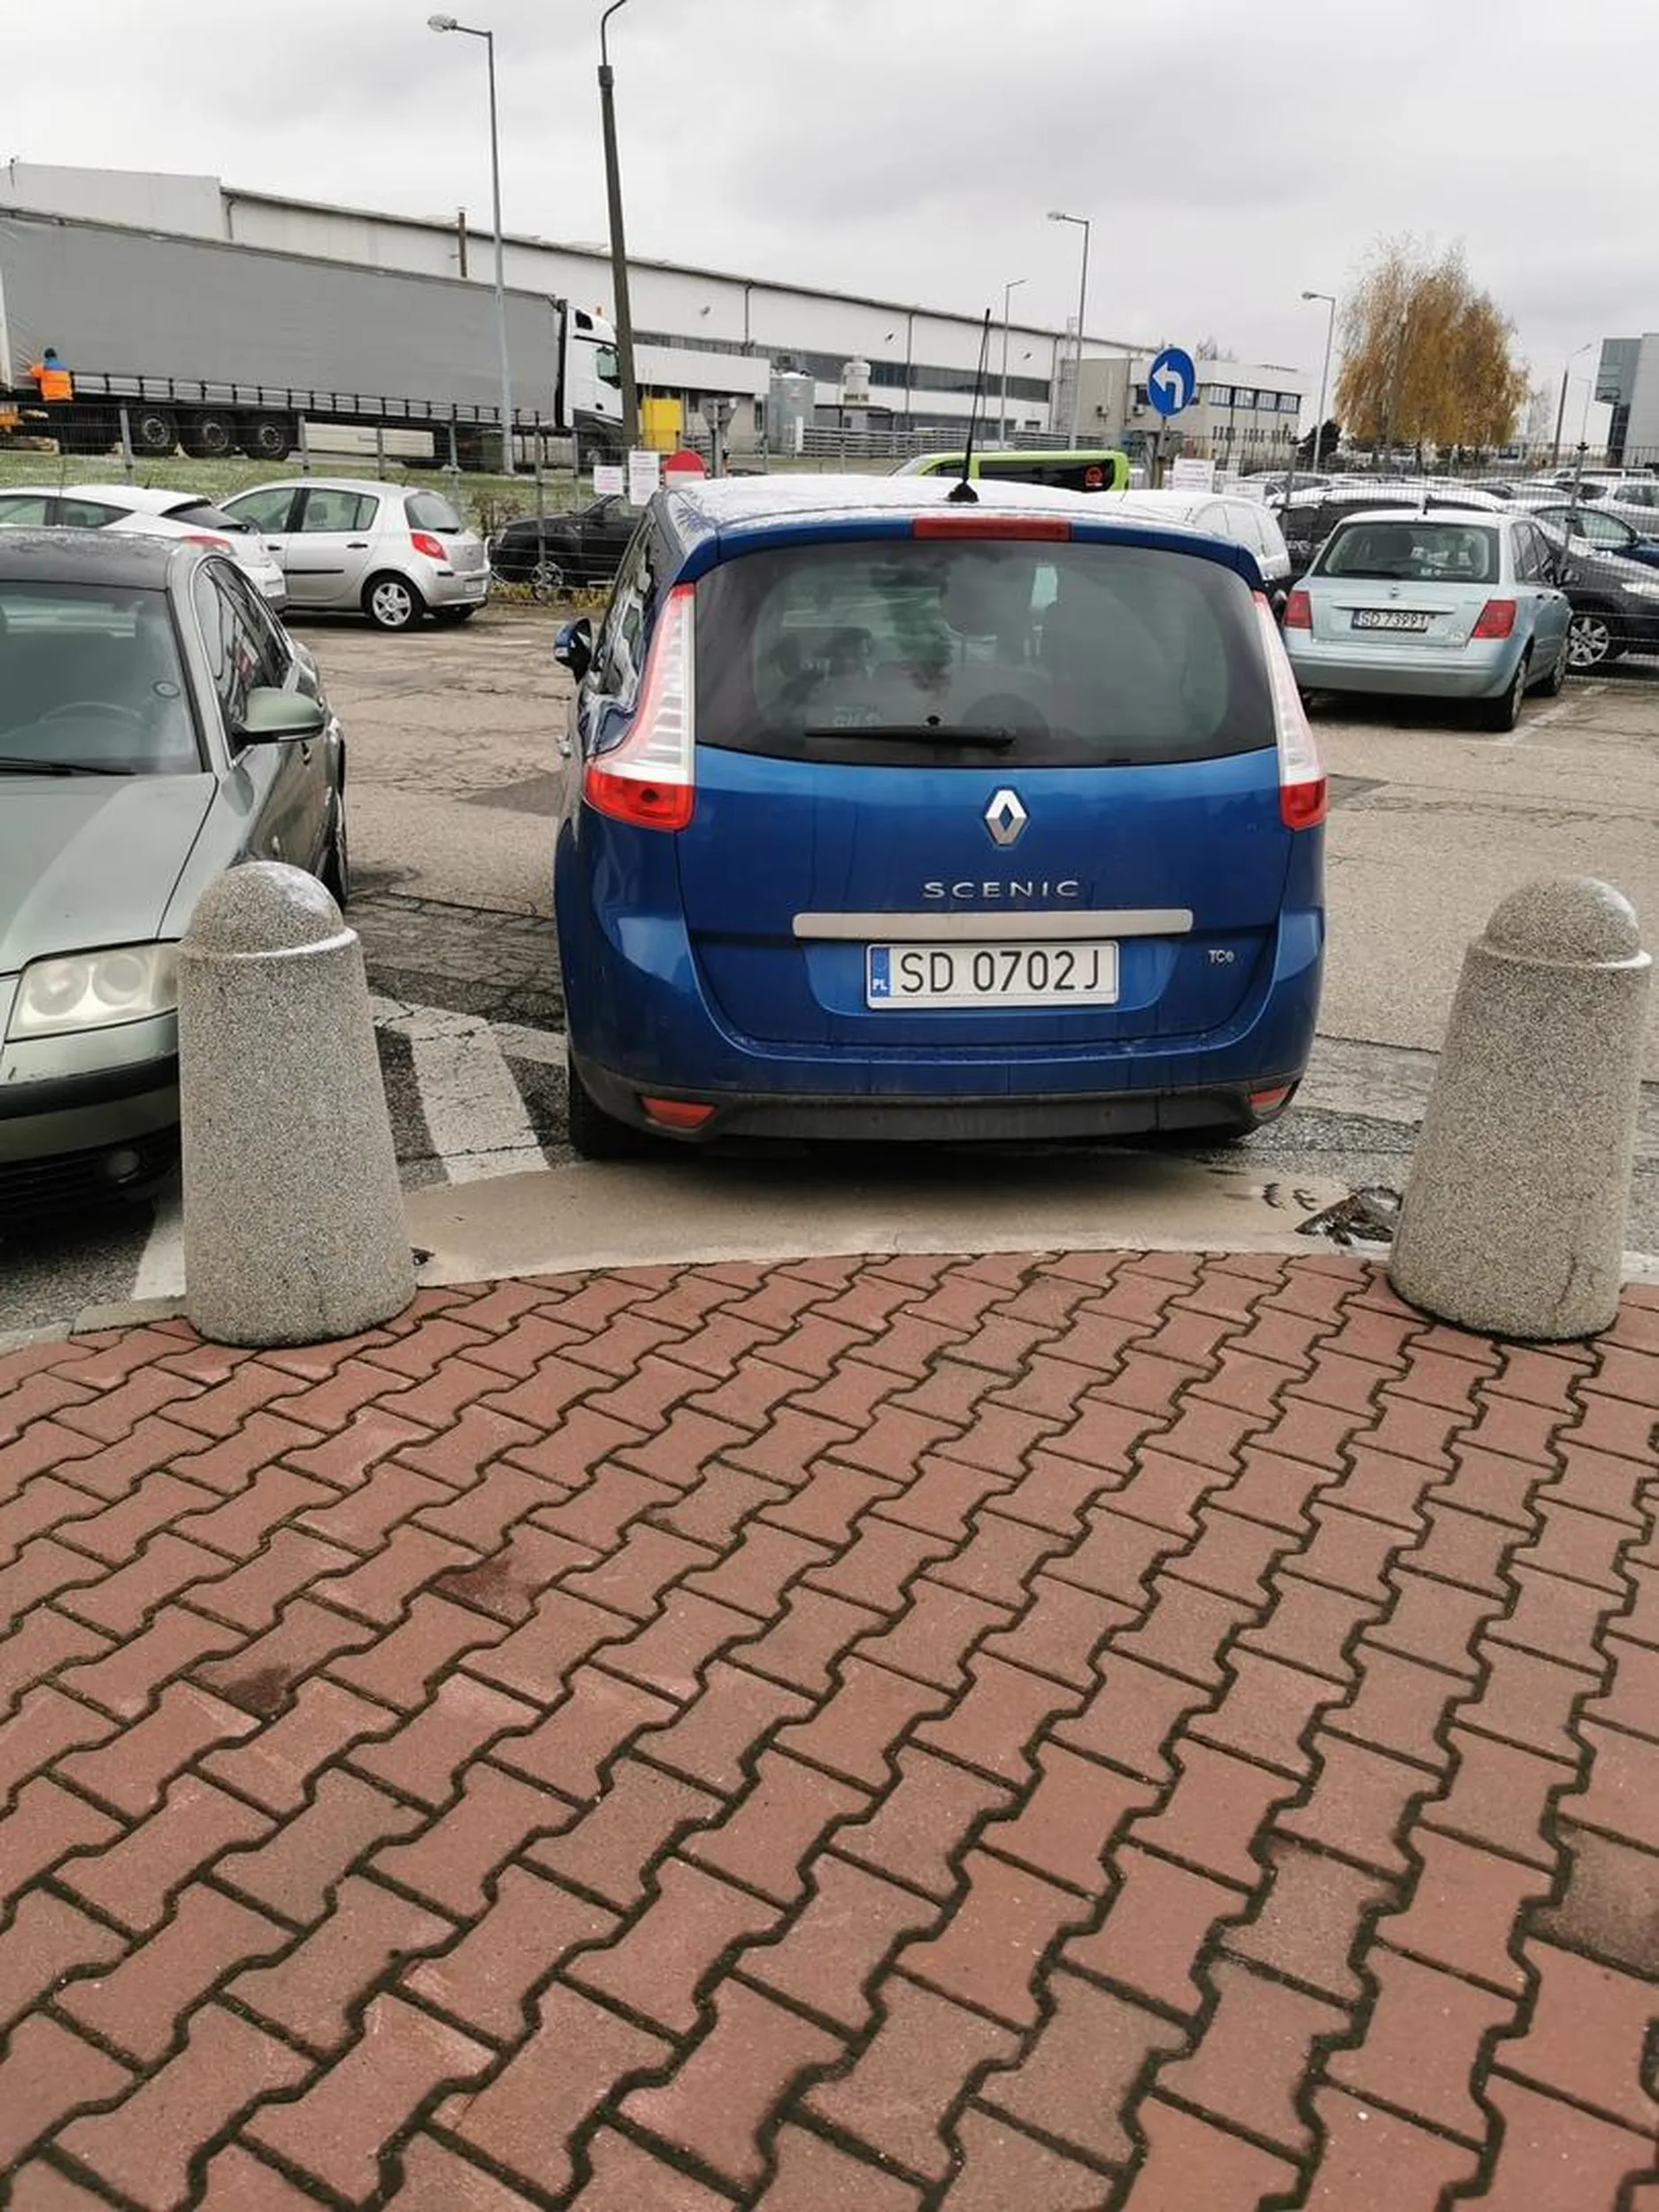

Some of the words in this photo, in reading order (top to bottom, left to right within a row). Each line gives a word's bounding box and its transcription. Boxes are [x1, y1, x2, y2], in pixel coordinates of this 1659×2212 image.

[924, 880, 1079, 899] SCENIC
[900, 952, 953, 993] SD
[972, 949, 1100, 992] 0702J
[872, 978, 888, 990] PL
